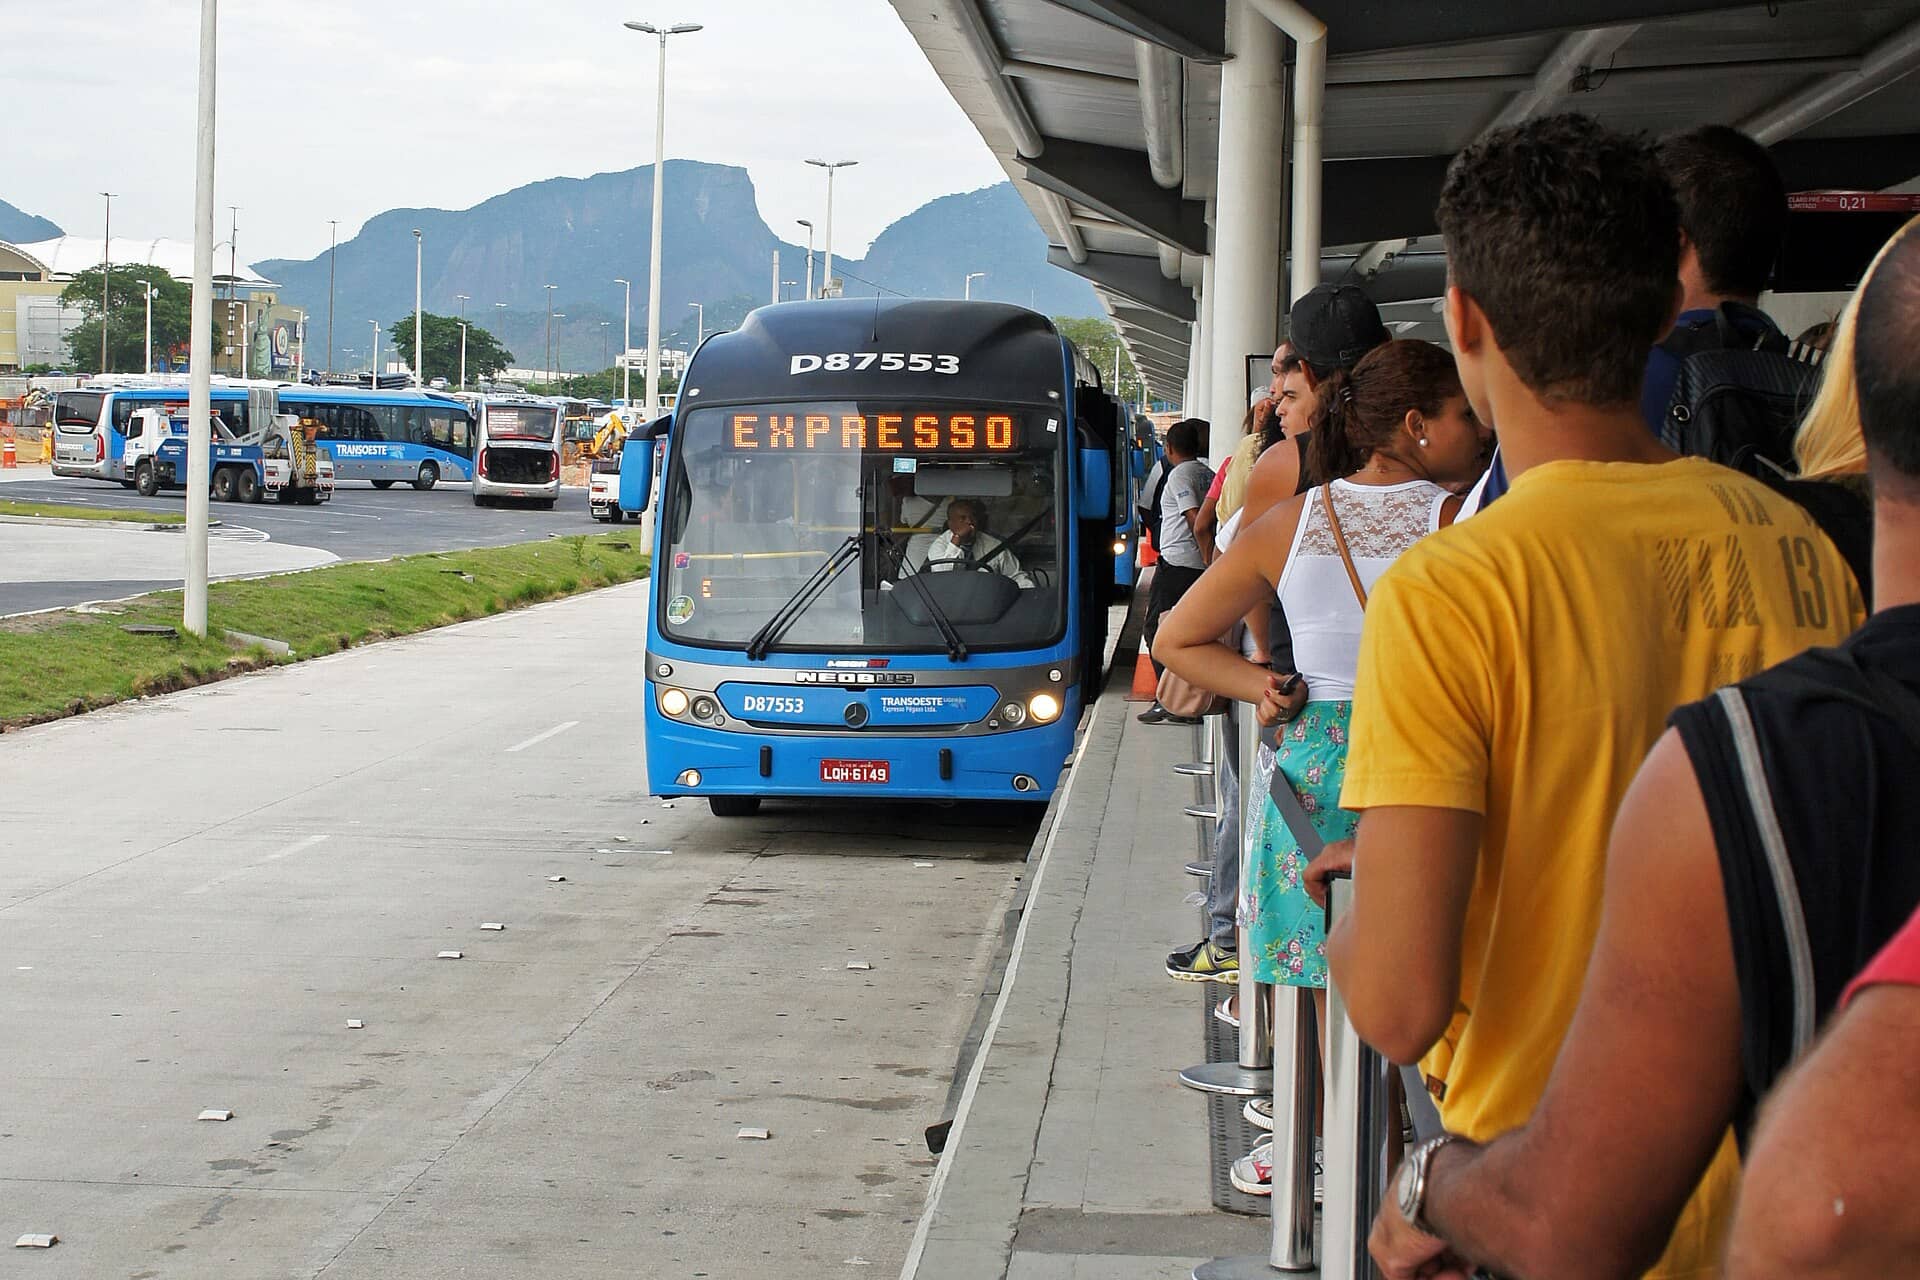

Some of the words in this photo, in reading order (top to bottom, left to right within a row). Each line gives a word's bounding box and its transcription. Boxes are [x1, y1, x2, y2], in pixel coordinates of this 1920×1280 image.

[1839, 197, 1866, 210] 0,21
[789, 352, 960, 375] D87553
[733, 415, 1013, 449] EXPRESSO
[336, 444, 388, 456] TRANSOESTE
[795, 671, 915, 684] NEOBUS
[743, 695, 804, 713] D87553
[881, 697, 944, 706] TRANSOESTE
